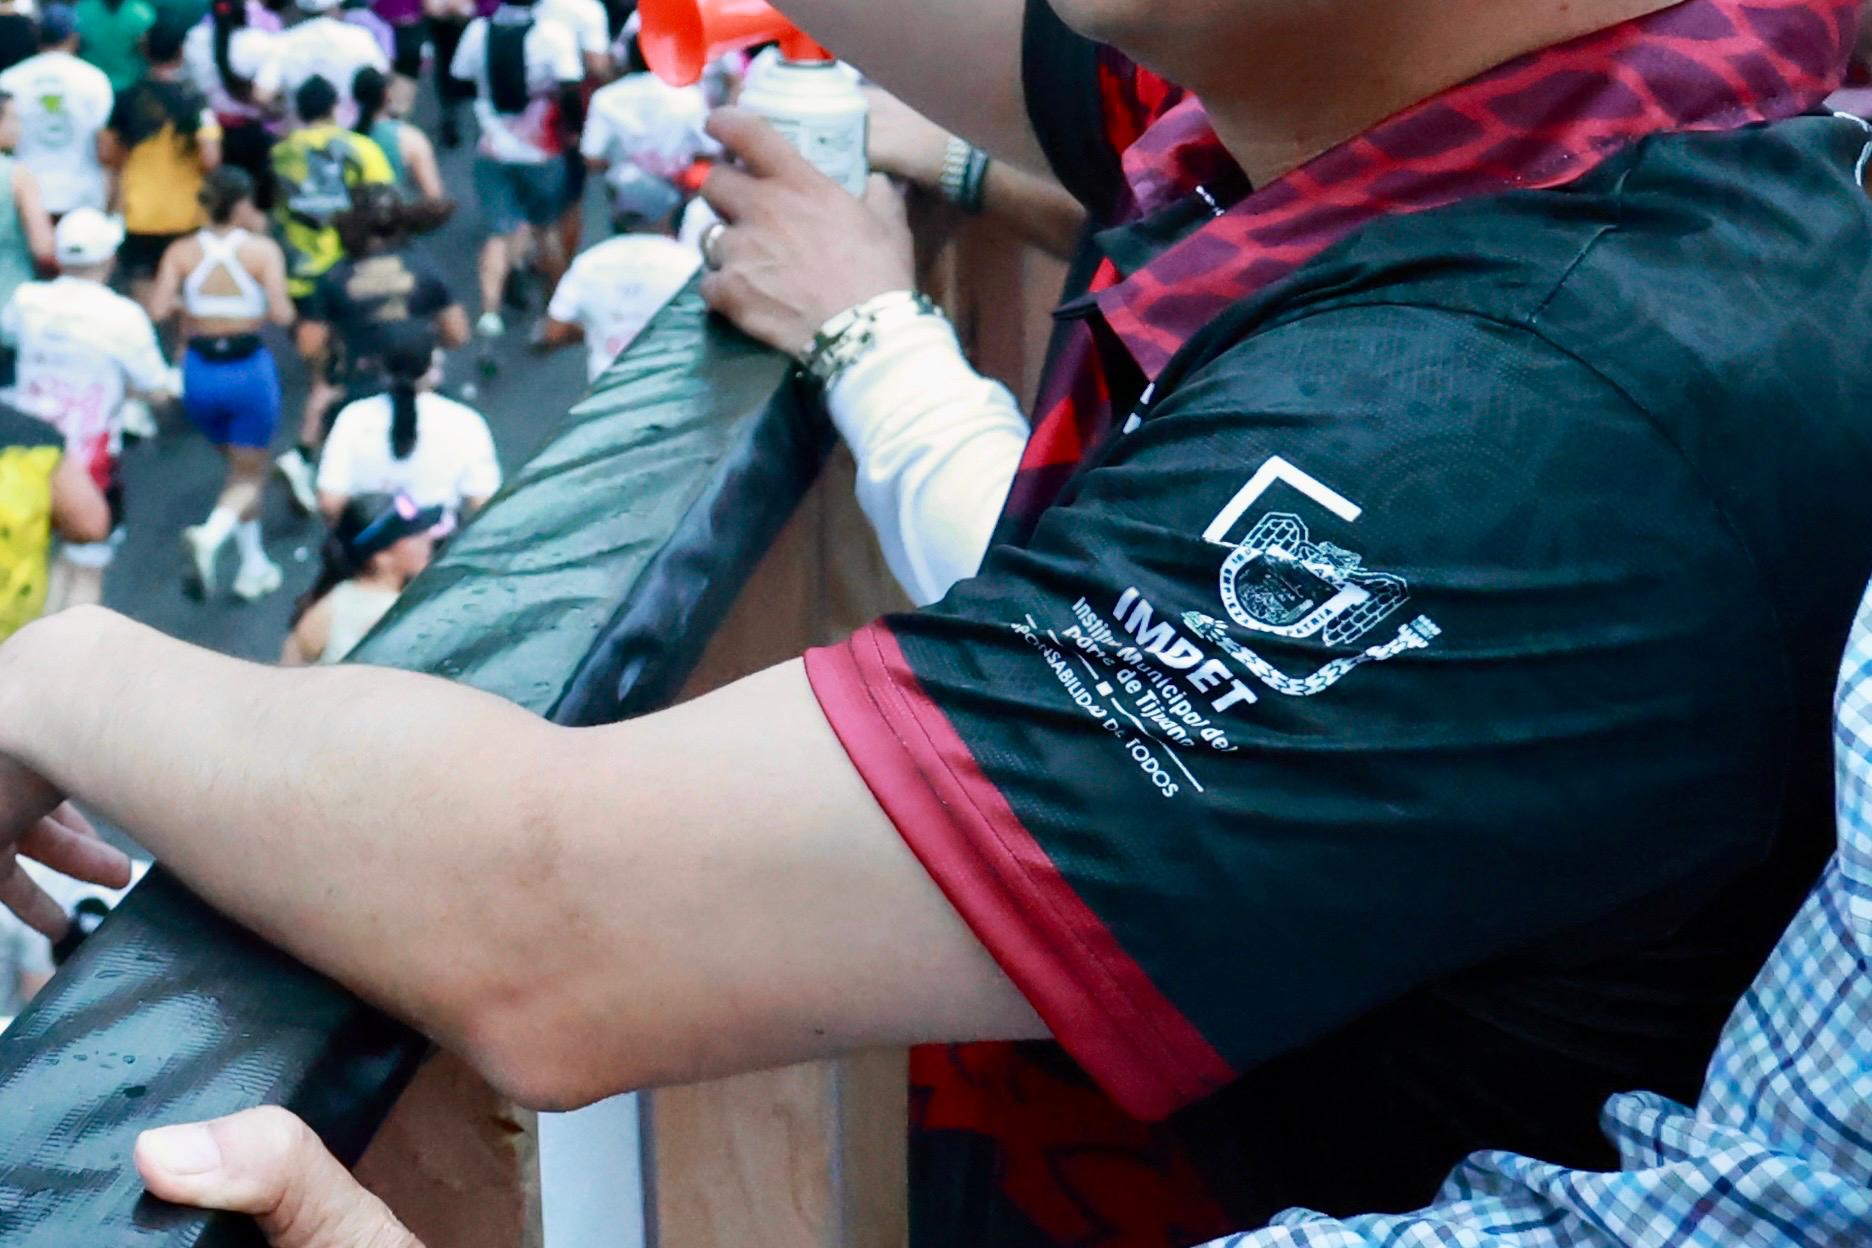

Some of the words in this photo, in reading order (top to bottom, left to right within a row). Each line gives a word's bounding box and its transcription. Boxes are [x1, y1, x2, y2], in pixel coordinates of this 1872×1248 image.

[1112, 586, 1258, 713] IMDET
[1117, 669, 1142, 694] de
[1116, 647, 1211, 728] Municipal
[1125, 738, 1179, 798] TODOS
